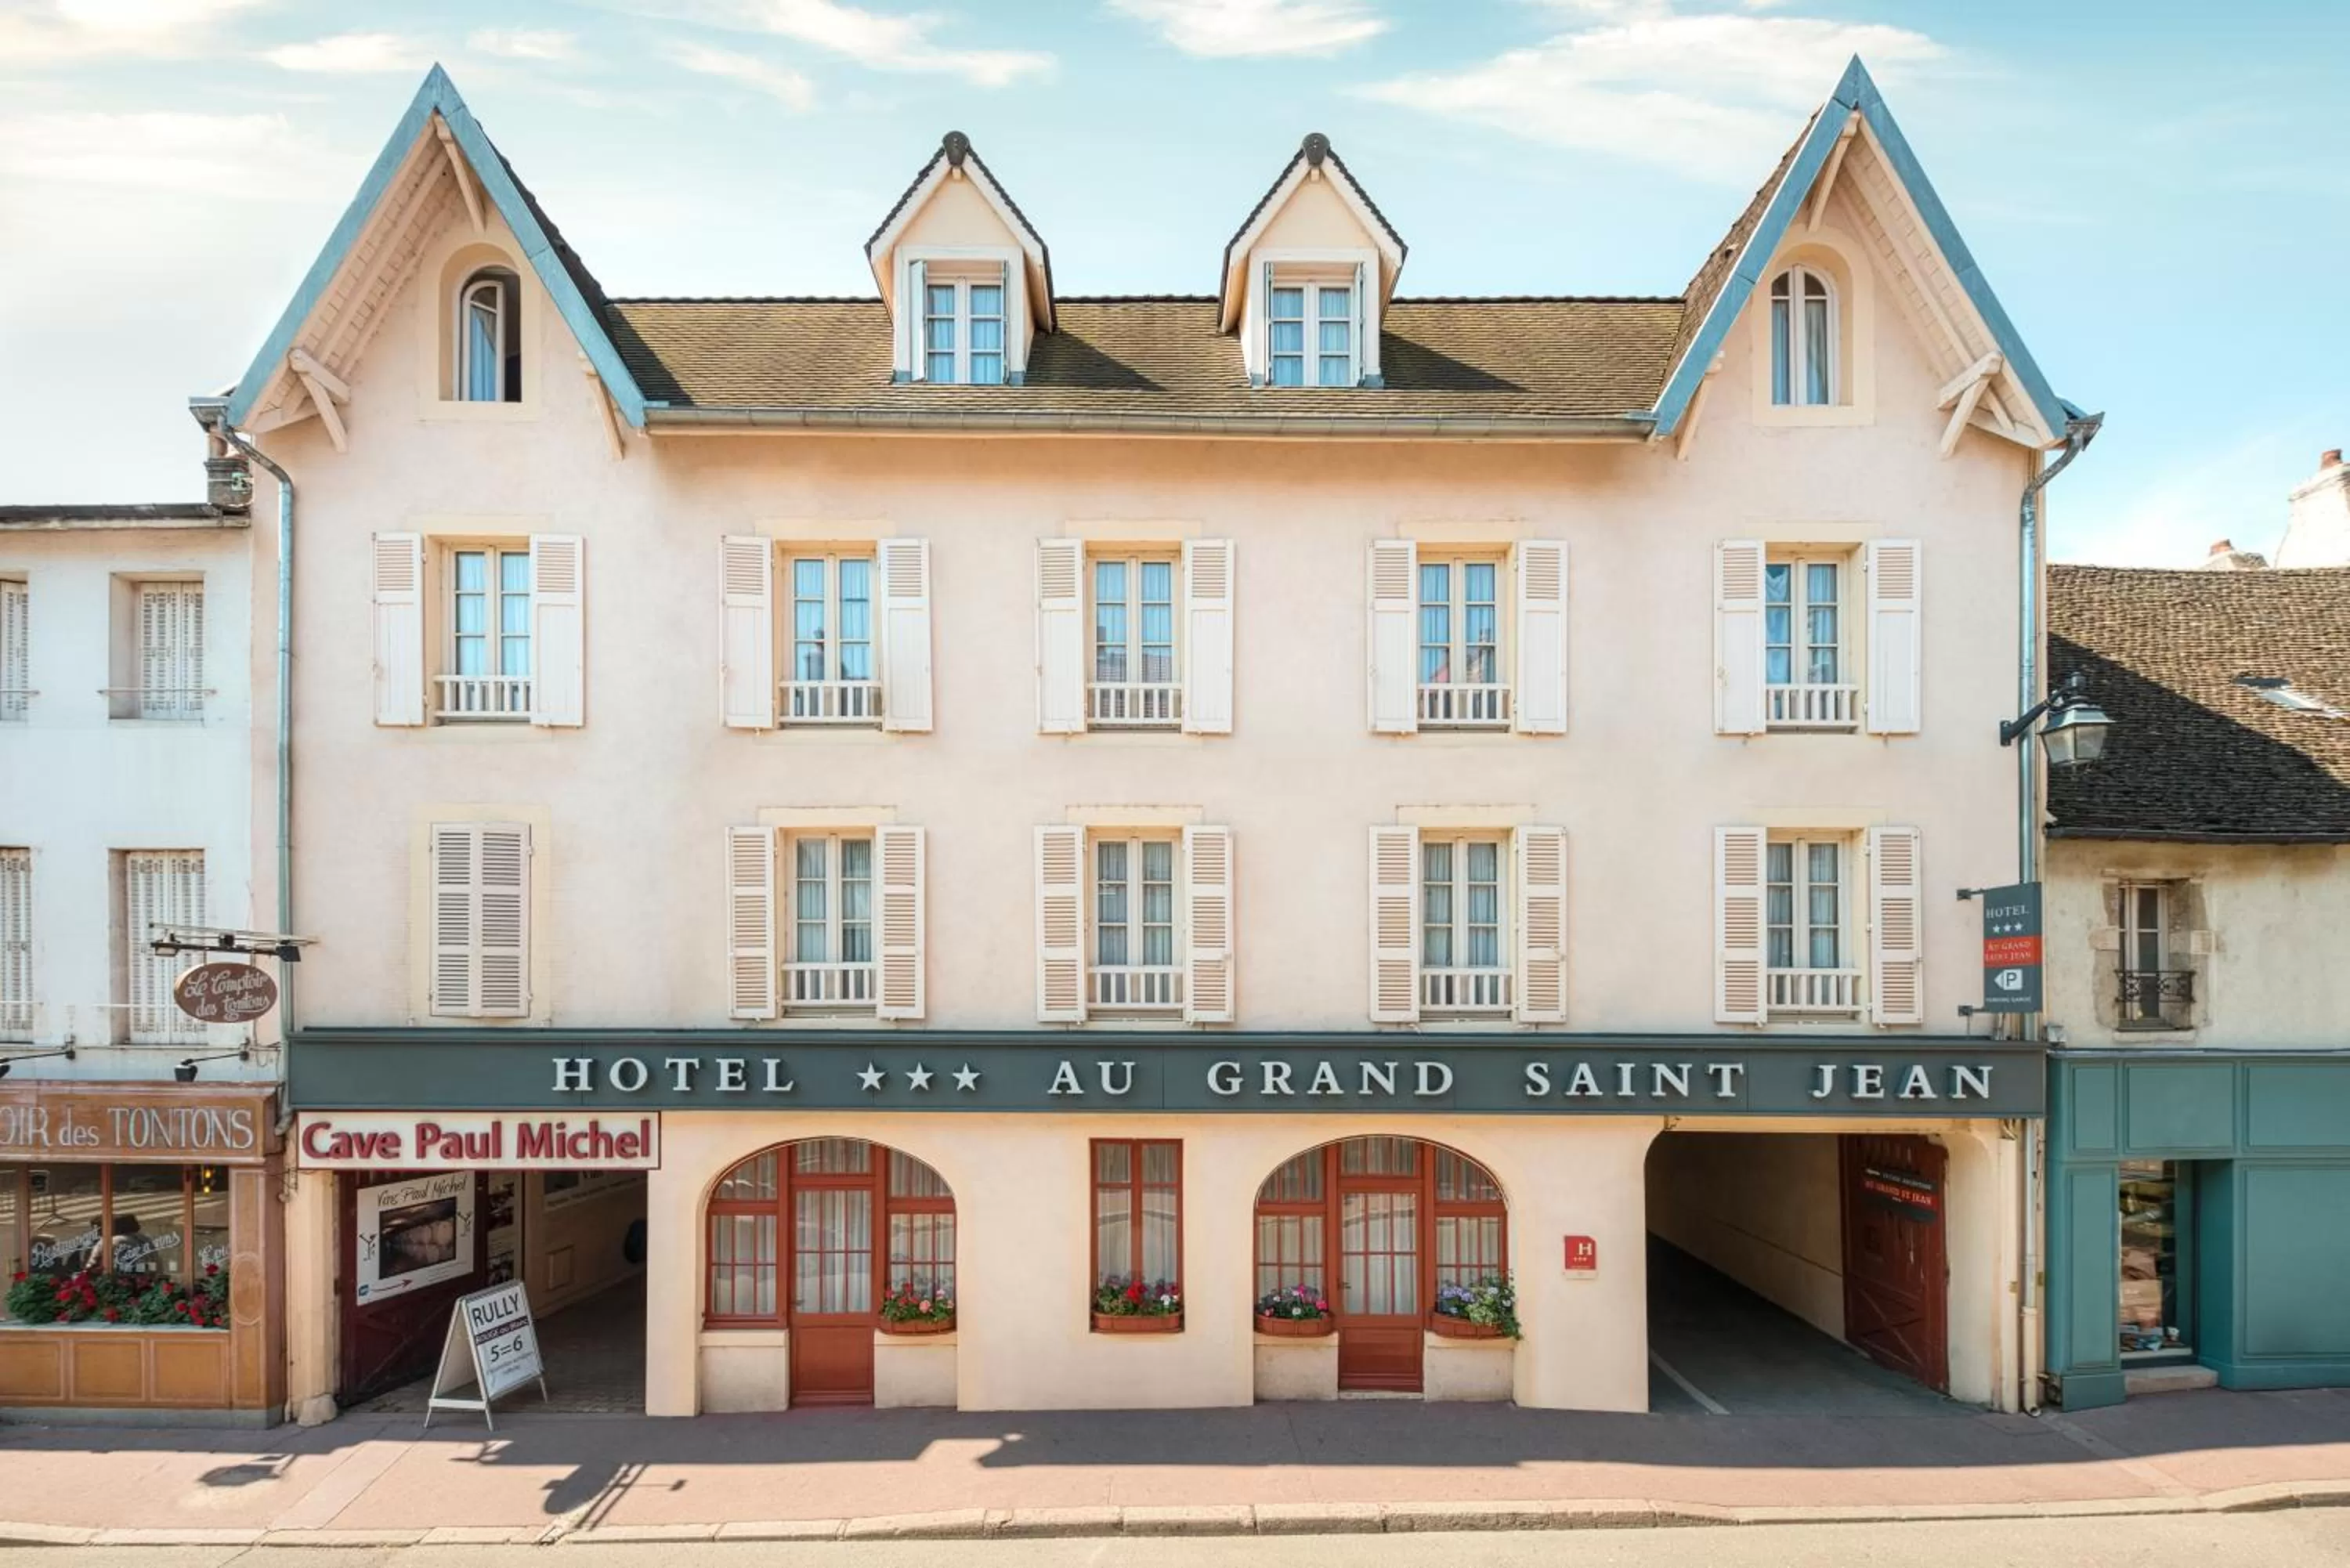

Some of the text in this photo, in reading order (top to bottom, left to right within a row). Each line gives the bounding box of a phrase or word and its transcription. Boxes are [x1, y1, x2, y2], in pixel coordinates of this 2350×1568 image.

[1986, 905, 2030, 919] HOTEL
[2001, 941, 2032, 951] GRAND
[2010, 951, 2032, 961] JEAN
[184, 970, 269, 999] Le Comptoir
[2005, 971, 2018, 988] P
[195, 996, 218, 1017] des
[552, 1057, 1993, 1099] HOTEL AU GRAND SAINT JEAN
[59, 1103, 100, 1147] des
[107, 1107, 255, 1149] TONTONS
[302, 1119, 650, 1160] Cave Paul Michel
[400, 1180, 430, 1201] Paul
[432, 1174, 468, 1198] Michel
[1578, 1243, 1593, 1255] H
[472, 1293, 519, 1328] RULLY
[490, 1334, 523, 1363] 5=6
